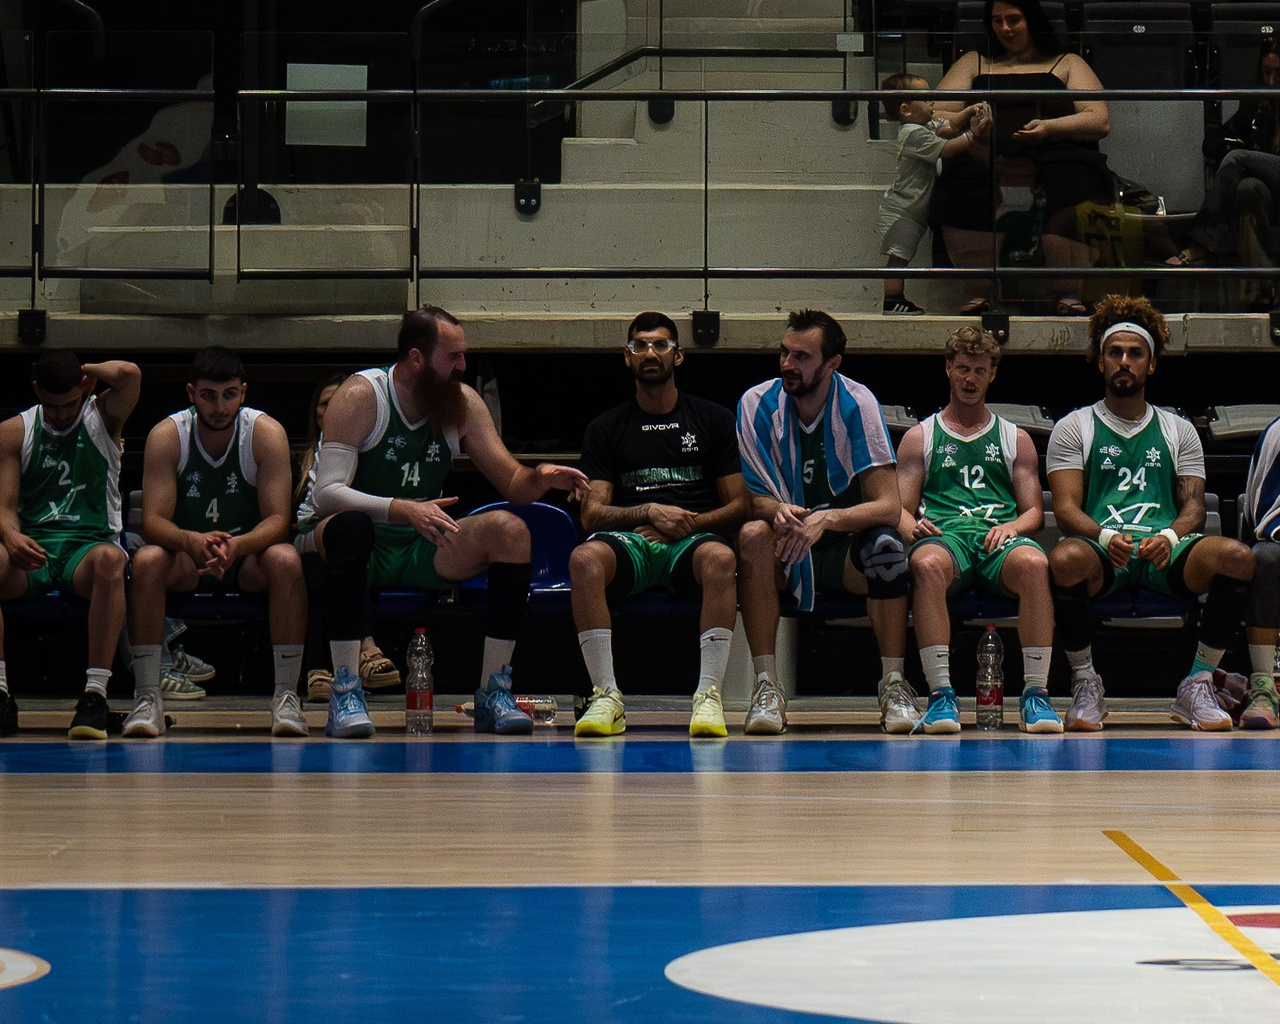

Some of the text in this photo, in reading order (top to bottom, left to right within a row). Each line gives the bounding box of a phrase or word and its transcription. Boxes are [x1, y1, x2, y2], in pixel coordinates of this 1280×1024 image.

[58, 460, 71, 486] 2
[401, 461, 421, 487] 14
[803, 459, 815, 485] 5
[959, 464, 986, 489] 12
[1117, 466, 1147, 492] 24
[205, 497, 220, 523] 4
[1100, 502, 1161, 526] XT
